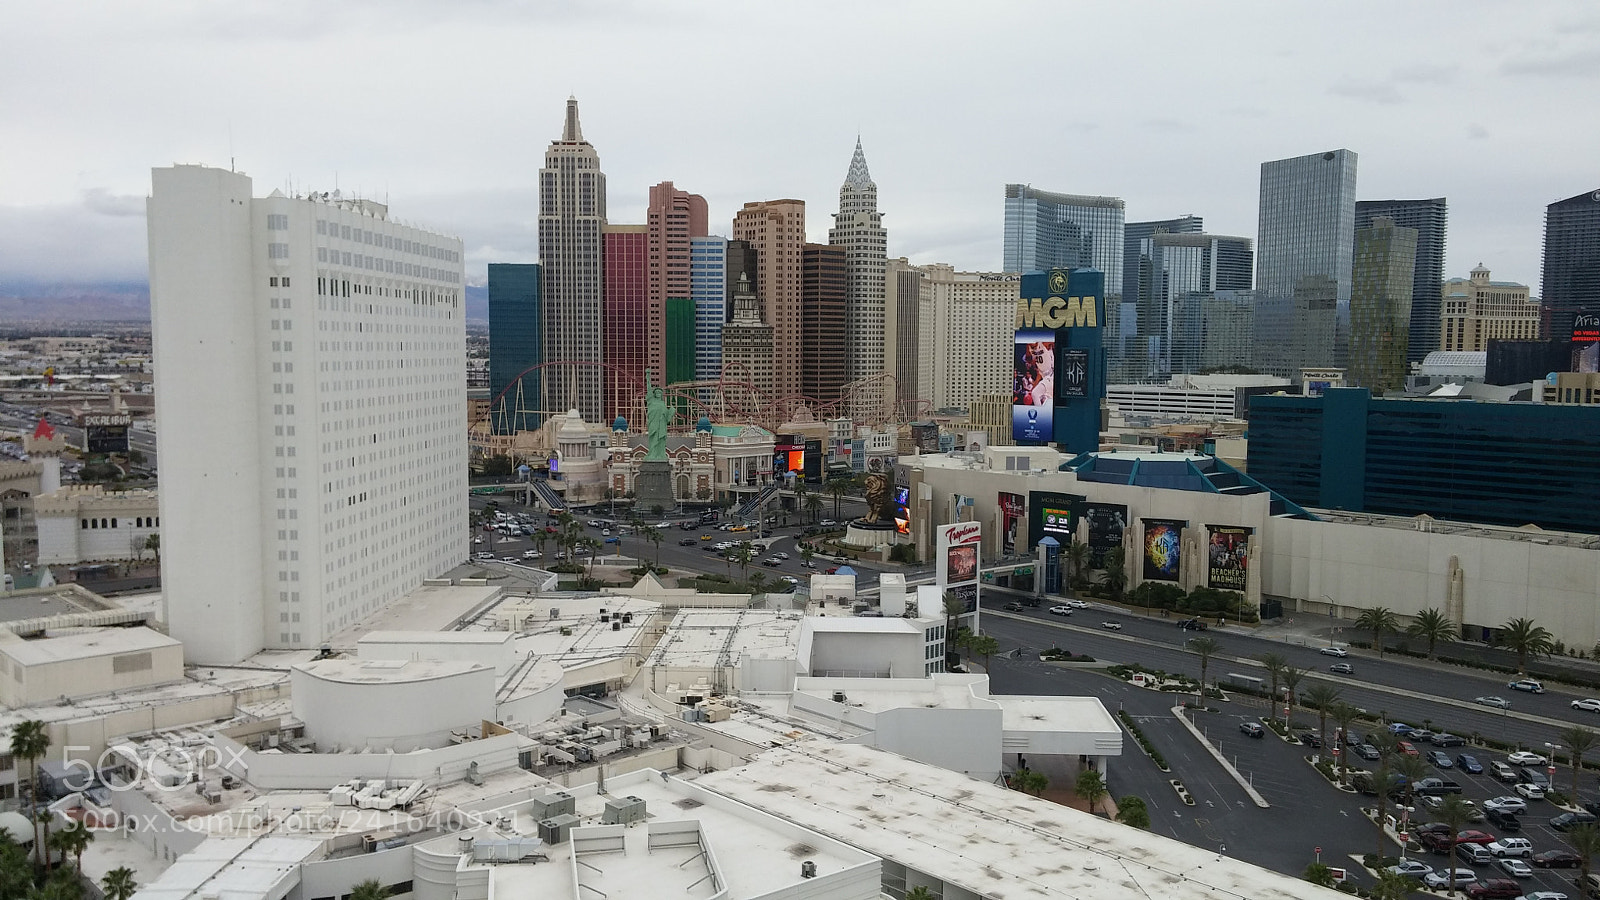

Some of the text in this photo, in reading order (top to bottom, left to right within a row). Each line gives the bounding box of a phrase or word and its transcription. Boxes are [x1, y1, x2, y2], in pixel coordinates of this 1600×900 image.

[1014, 296, 1097, 329] MGM
[1575, 315, 1600, 327] Aria
[85, 415, 131, 426] EXCALIBUR
[1211, 567, 1246, 578] BEACHER'S
[1210, 575, 1246, 584] MADHOUSE
